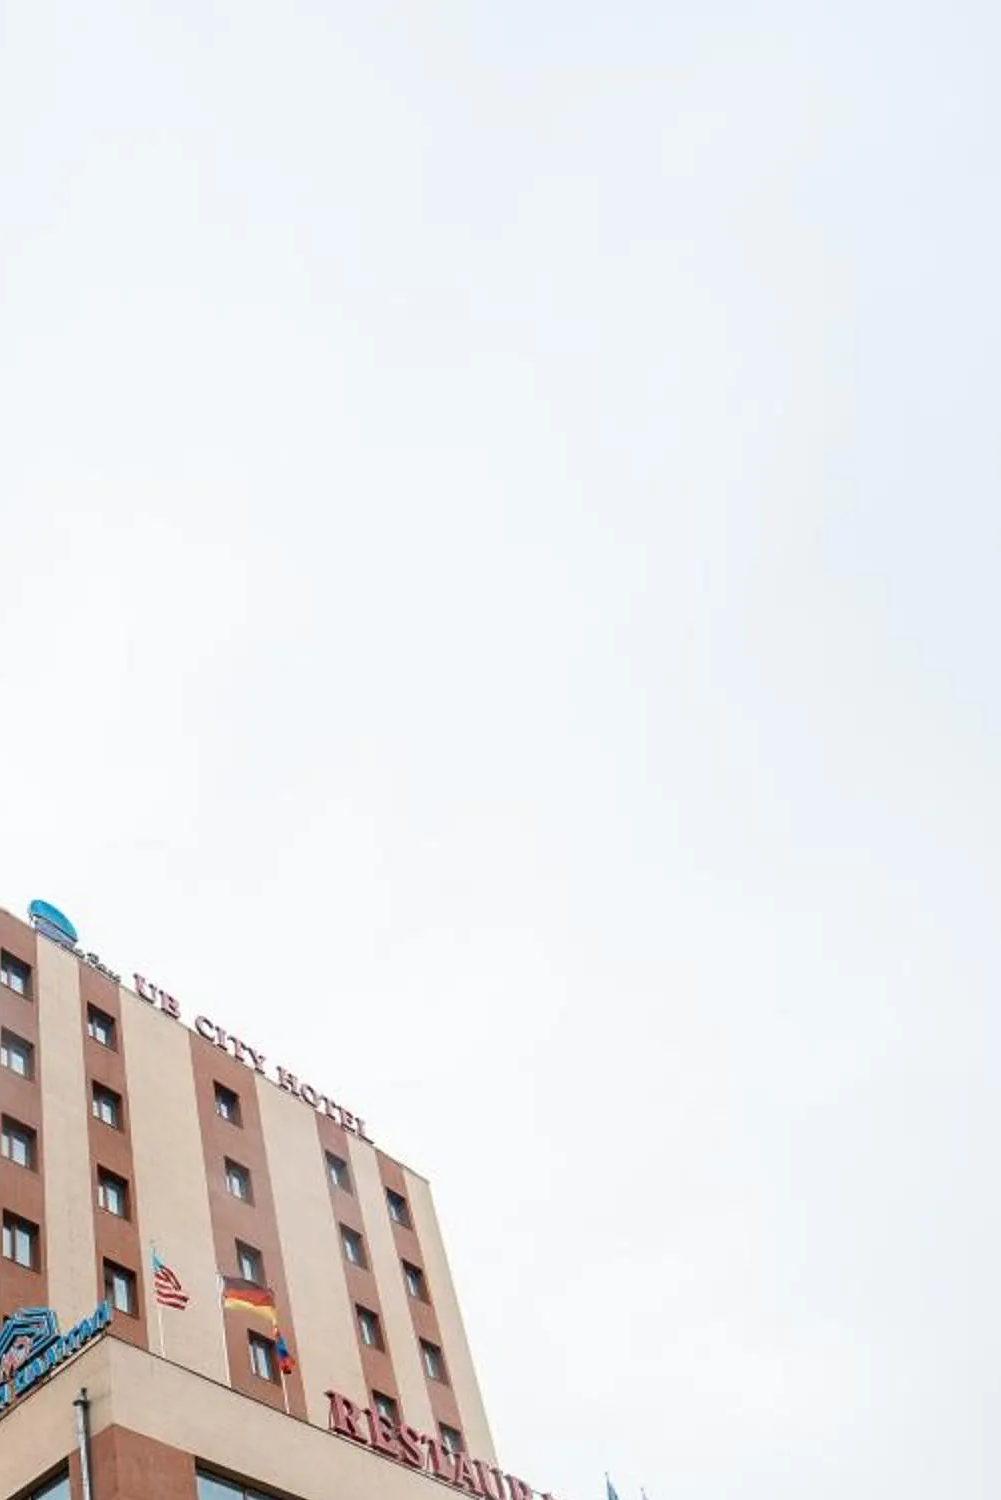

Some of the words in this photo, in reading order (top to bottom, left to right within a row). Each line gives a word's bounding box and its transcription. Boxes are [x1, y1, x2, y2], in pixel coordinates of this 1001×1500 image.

[133, 972, 181, 1019] UB
[194, 1015, 267, 1075] CITY
[276, 1065, 375, 1144] HOTEL
